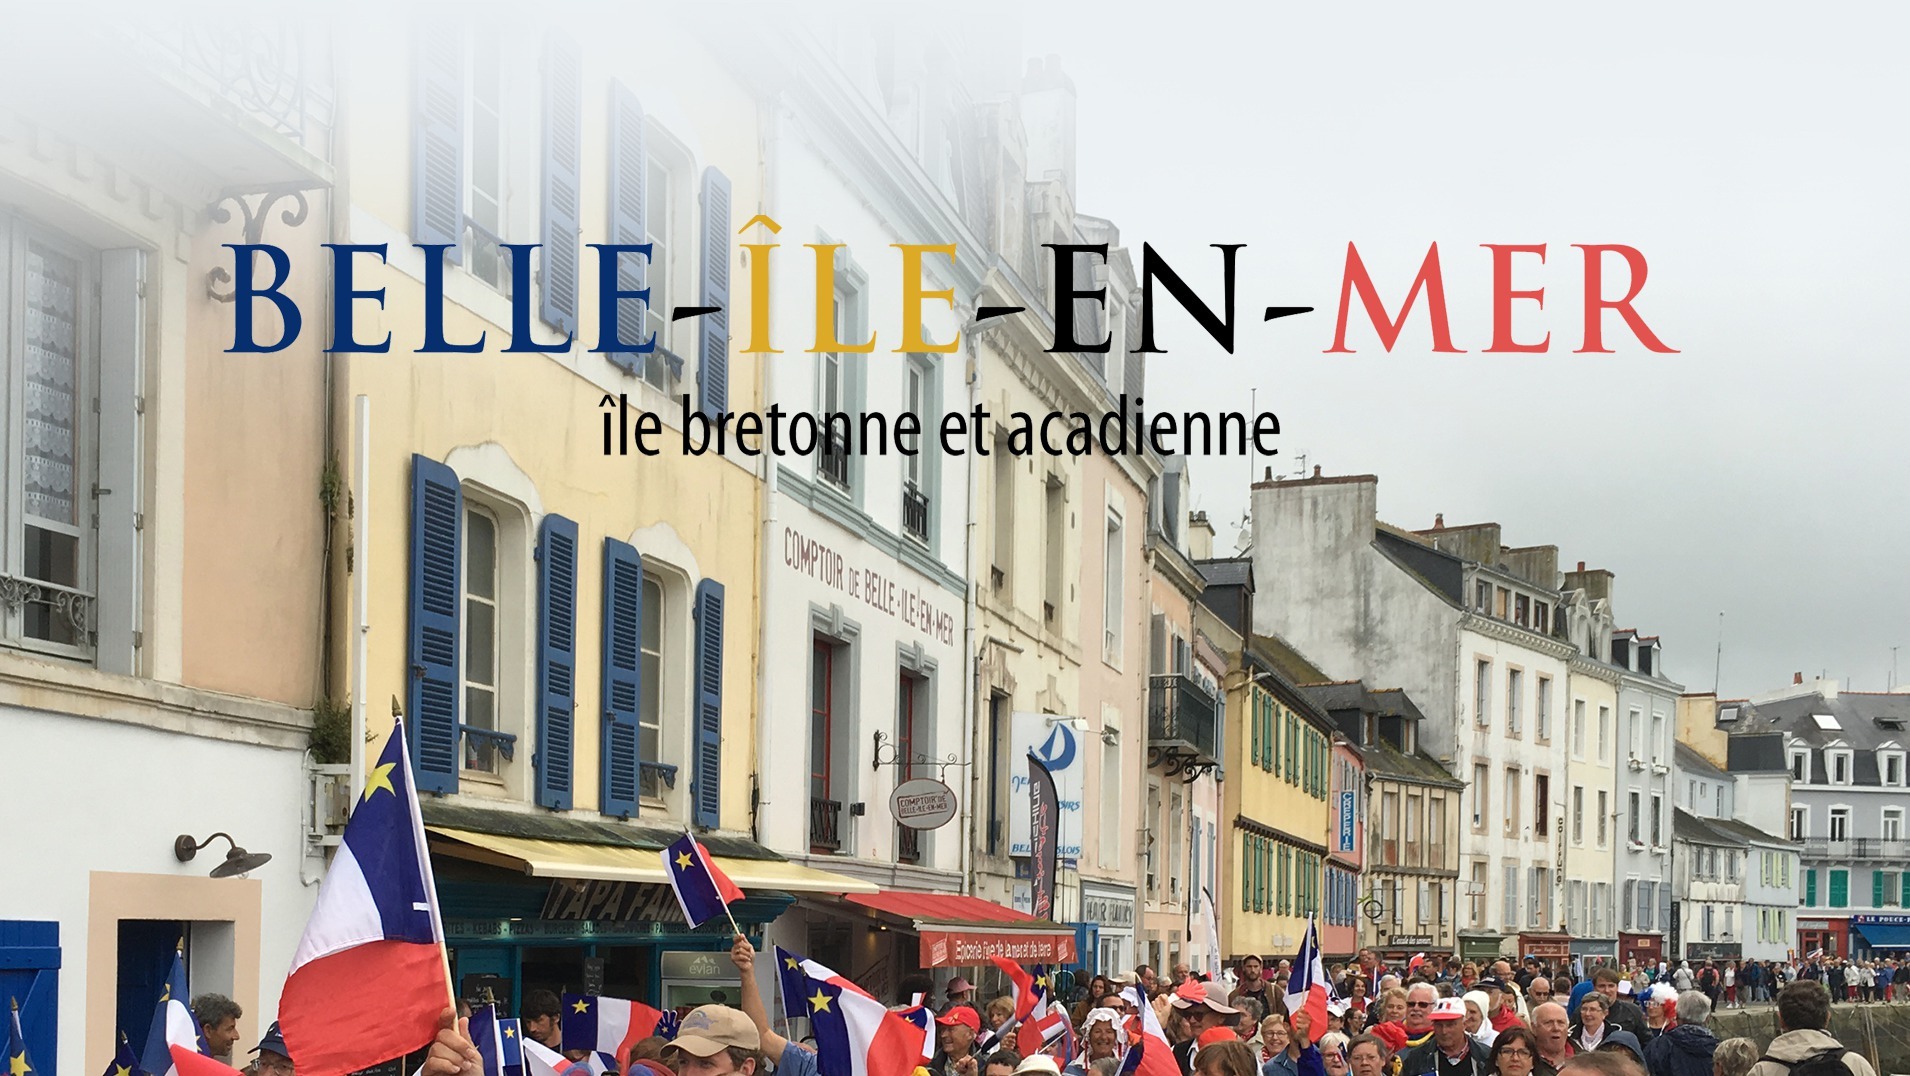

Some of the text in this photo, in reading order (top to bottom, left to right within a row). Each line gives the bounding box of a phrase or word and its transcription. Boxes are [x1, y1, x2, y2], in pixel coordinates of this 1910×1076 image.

[784, 526, 844, 591] COMPTOIR
[848, 567, 860, 600] DE
[900, 795, 937, 808] COMPTOIR
[547, 877, 627, 921] TAPA
[470, 921, 502, 935] KEBABS
[688, 963, 721, 975] evian
